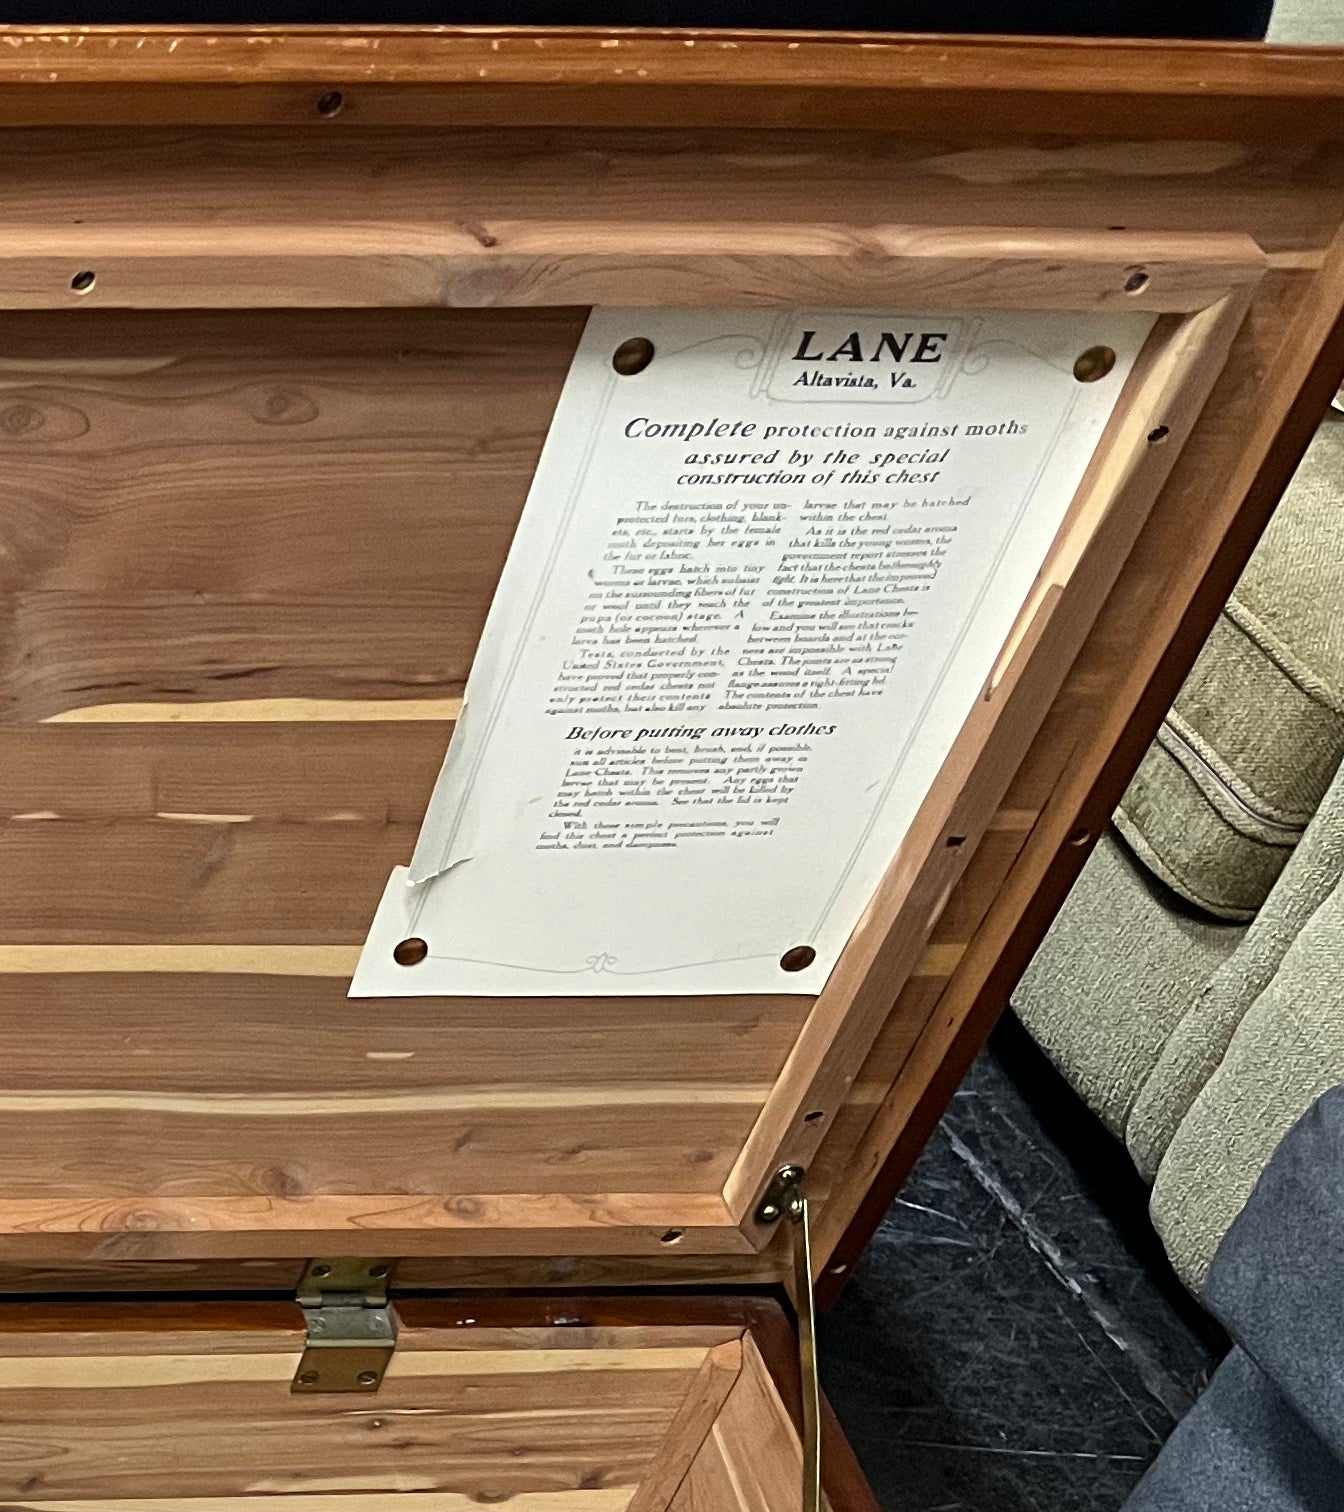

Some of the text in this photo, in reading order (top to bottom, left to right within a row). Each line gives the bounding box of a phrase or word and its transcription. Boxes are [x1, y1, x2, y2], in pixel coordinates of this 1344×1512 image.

[791, 331, 948, 363] LANE
[792, 371, 917, 390] Altavista, Va.
[624, 417, 1029, 441] Complete protection against moths
[684, 449, 951, 467] assured by the special
[676, 469, 941, 486] construction of this chest
[564, 722, 837, 741] Before putting away clothes
